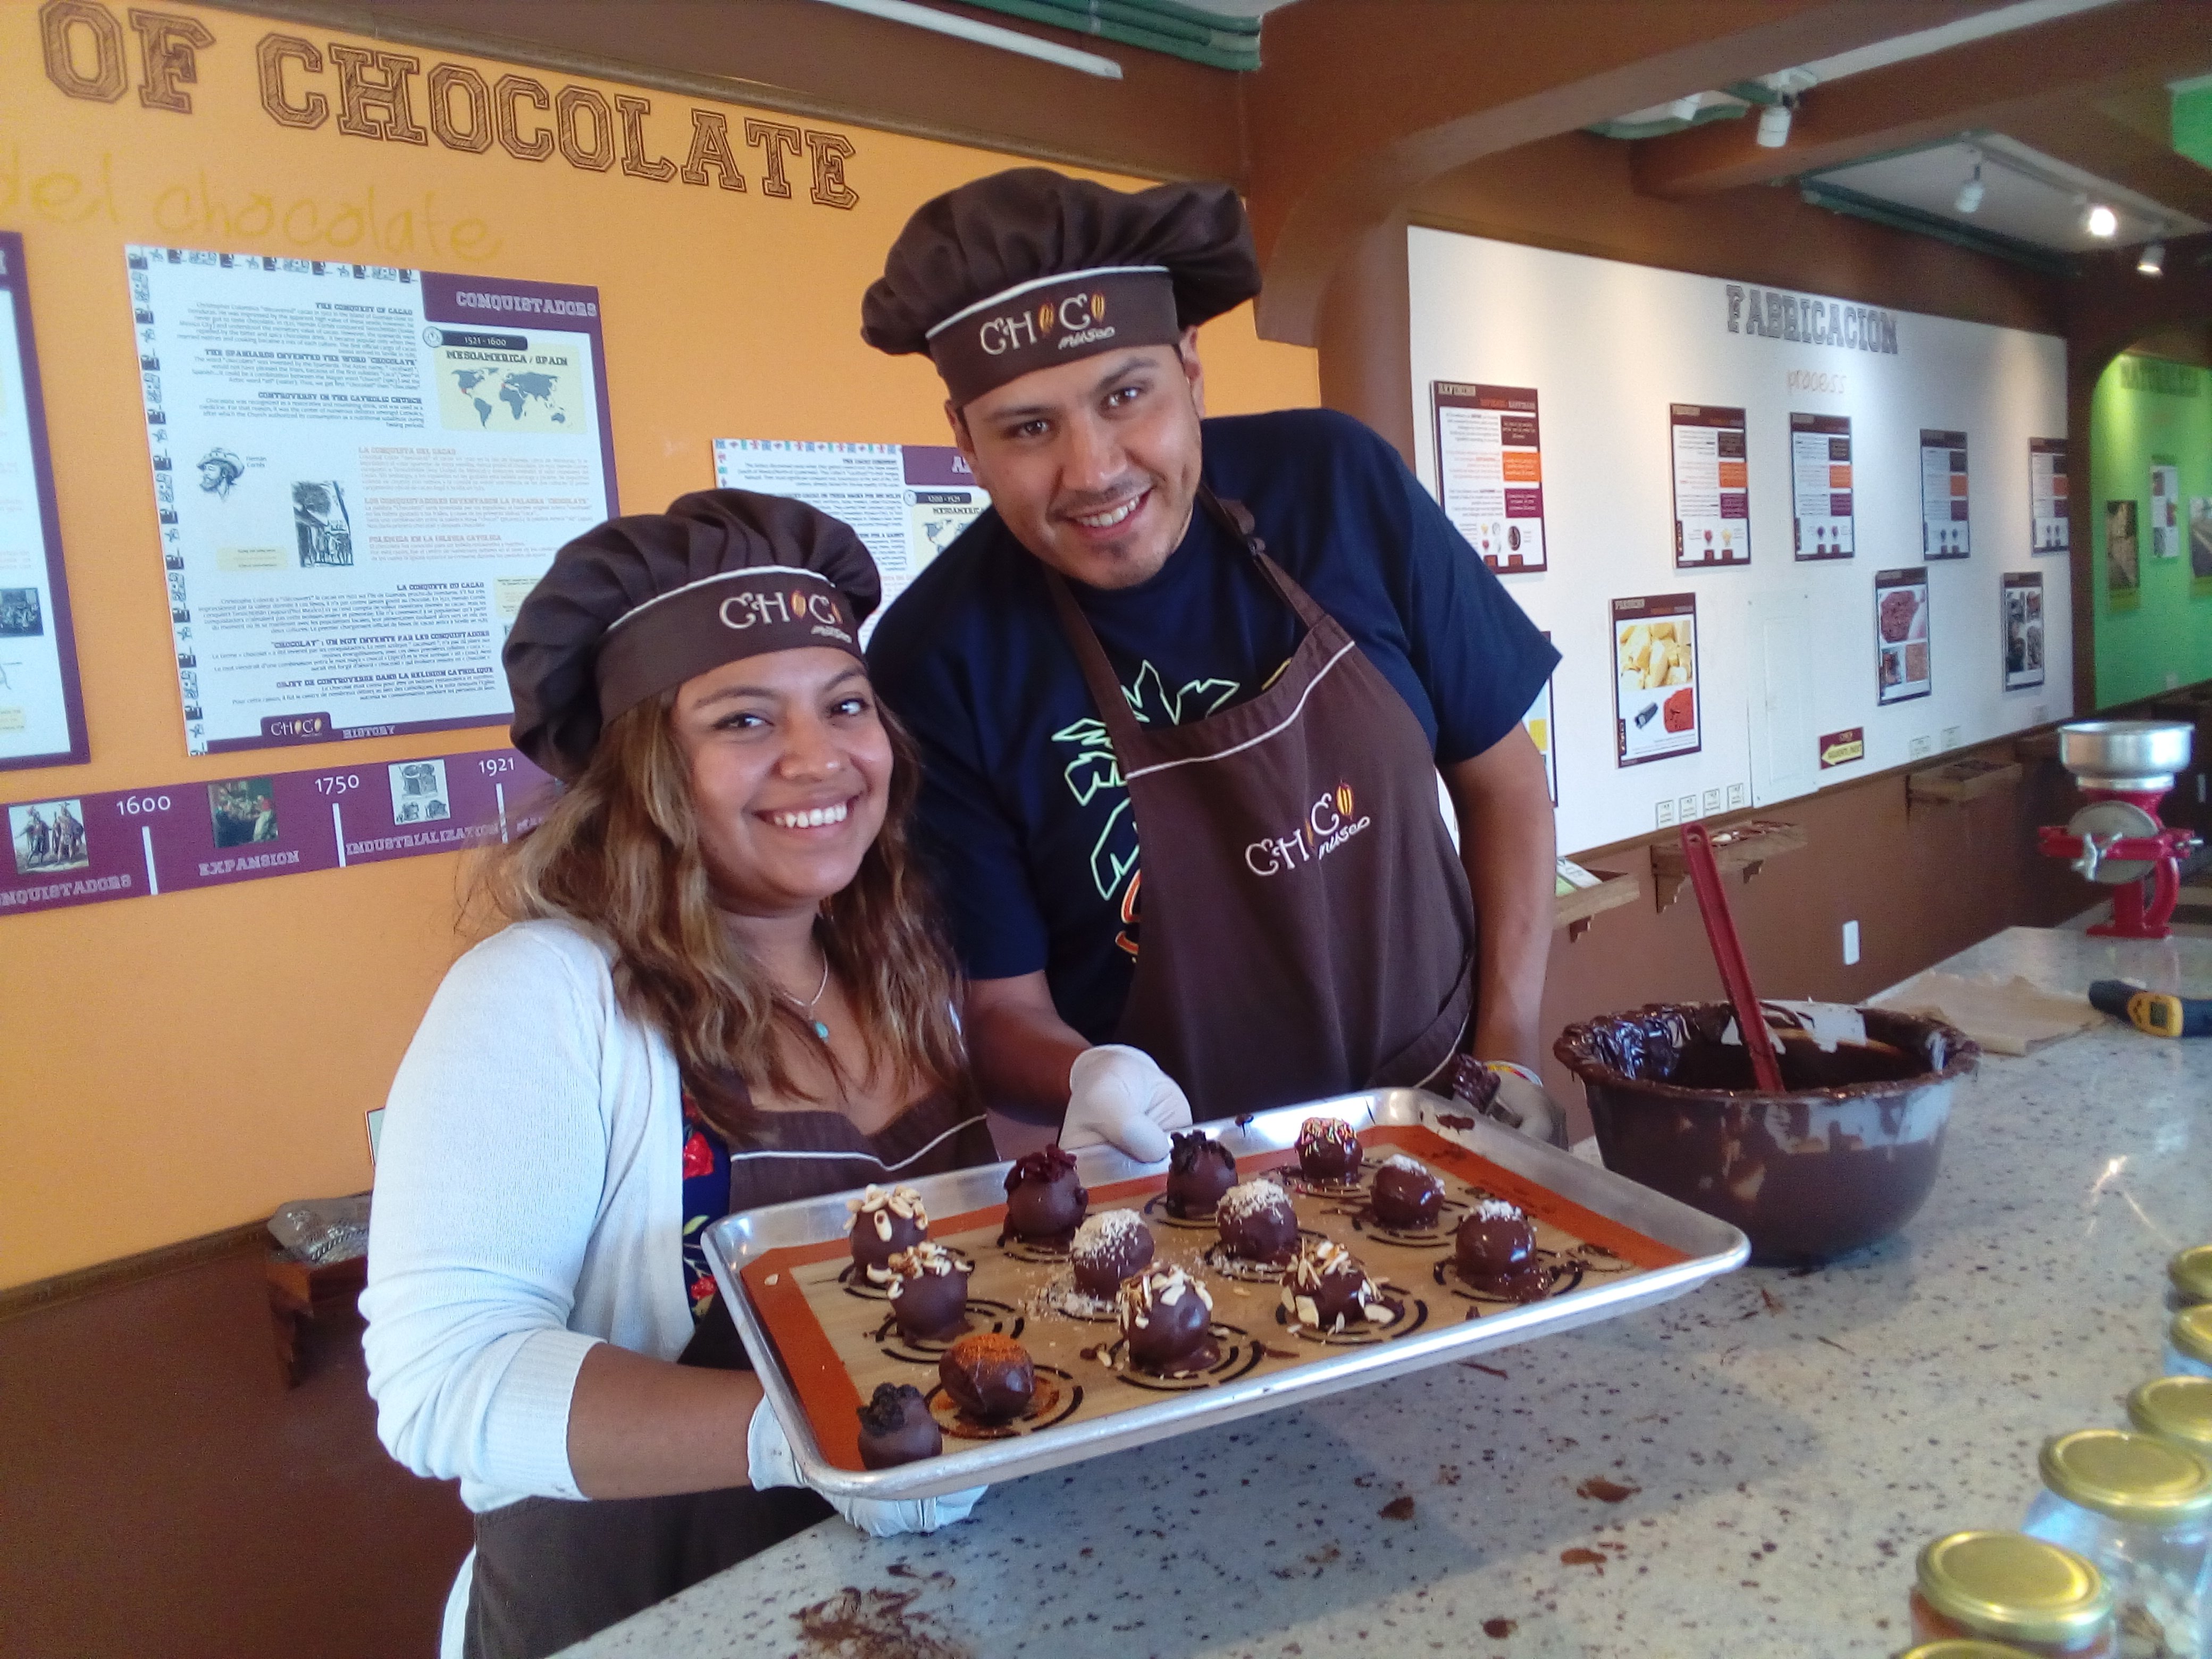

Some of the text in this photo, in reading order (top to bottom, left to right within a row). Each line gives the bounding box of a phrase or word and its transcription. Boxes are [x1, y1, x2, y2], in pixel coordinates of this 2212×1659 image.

[39, 0, 859, 210] OF CHOCOLATE
[153, 169, 503, 262] chocolate
[456, 291, 598, 317] CONQUISTADORS
[464, 336, 481, 345] 1521
[487, 337, 507, 346] 1600
[535, 356, 568, 366] SPAIN
[342, 725, 395, 739] HISTORY
[479, 757, 515, 776] 1921
[315, 774, 359, 795] 1750
[116, 796, 171, 815] 1600
[346, 822, 499, 854] INDUSTRIALIZATION
[198, 851, 300, 876] EXPANSION
[0, 874, 131, 907] NQUISTADORS
